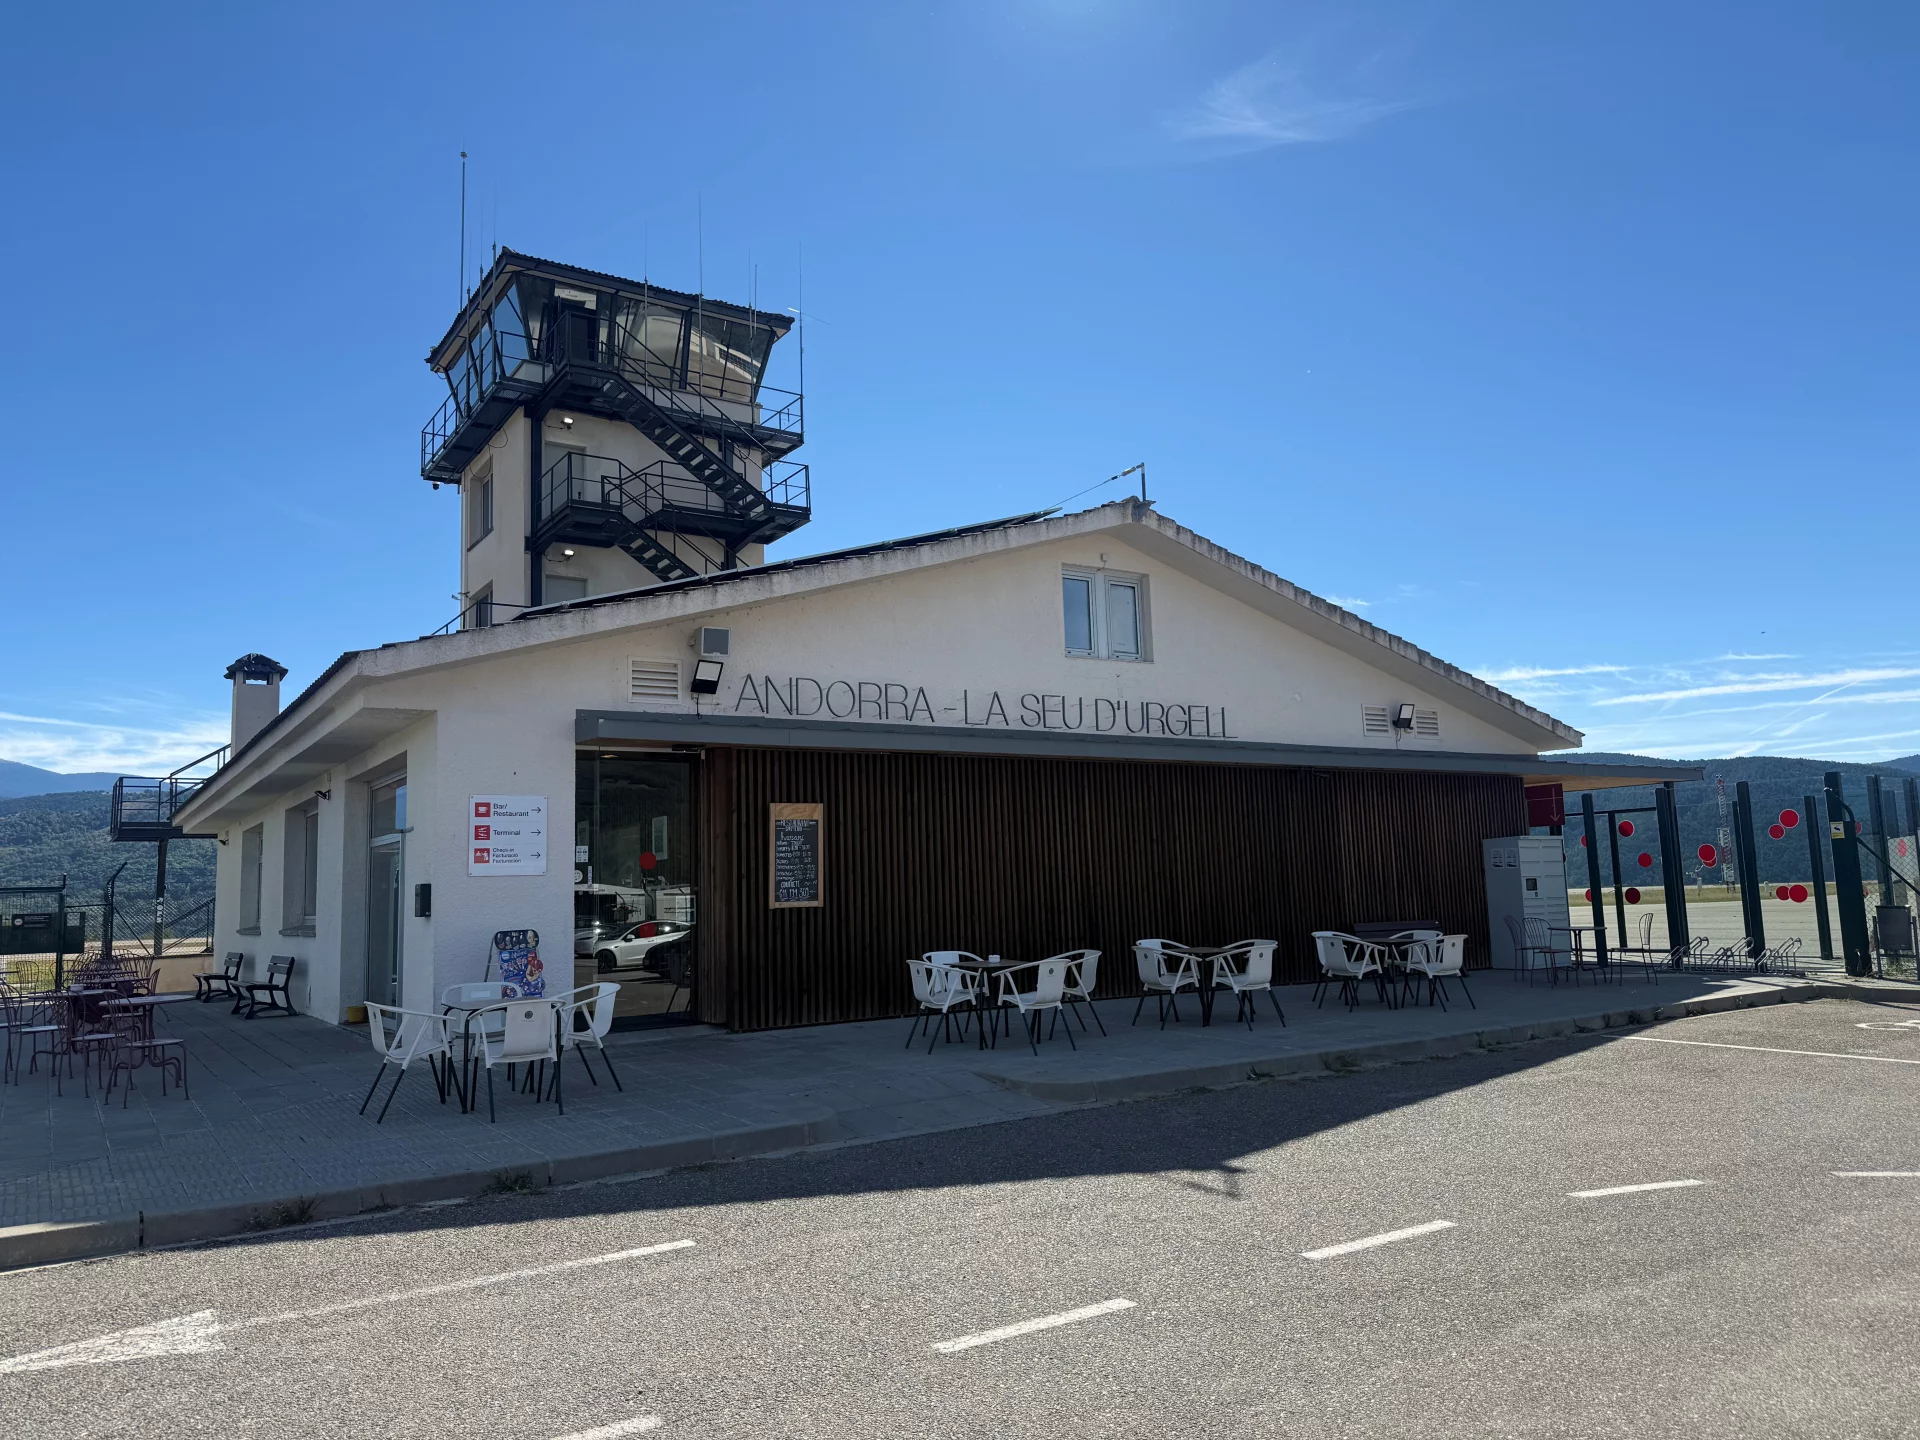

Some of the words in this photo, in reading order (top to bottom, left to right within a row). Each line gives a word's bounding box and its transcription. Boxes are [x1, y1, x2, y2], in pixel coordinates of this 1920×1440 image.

[735, 673, 935, 723] ANDORRA
[964, 689, 1009, 726] LA
[1020, 693, 1083, 730] SEU
[1094, 698, 1239, 739] D'URGELL
